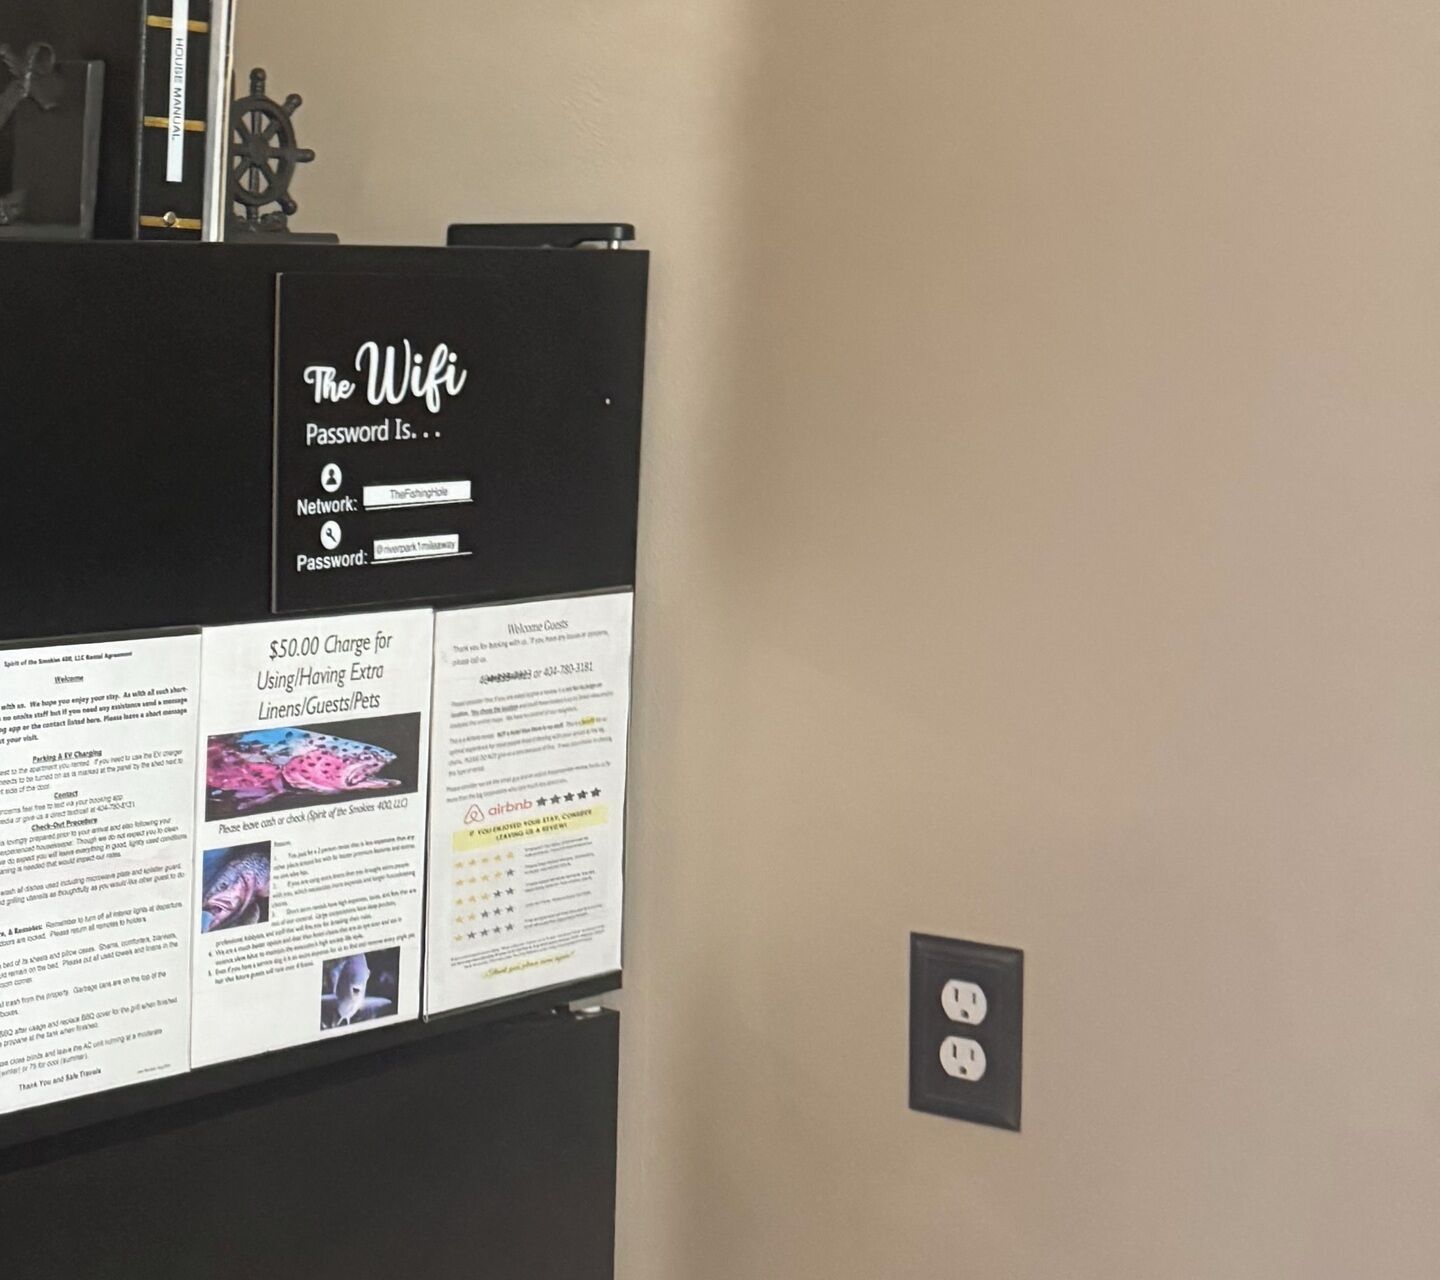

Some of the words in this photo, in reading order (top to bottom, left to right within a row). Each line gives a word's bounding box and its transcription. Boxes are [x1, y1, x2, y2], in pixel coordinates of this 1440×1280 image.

[173, 38, 184, 84] HOUSE
[171, 87, 182, 140] MANUAL
[304, 366, 355, 404] The
[355, 338, 467, 414] Wifi
[306, 418, 389, 446] Password
[297, 495, 358, 516] Network:
[297, 549, 368, 572] Password:
[507, 620, 543, 636] Welcome
[543, 618, 569, 631] Guests
[269, 636, 319, 661] $50.00
[324, 634, 371, 656] Charge
[374, 630, 393, 654] for
[54, 674, 83, 685] Welcome
[257, 666, 346, 693] Using/Having
[350, 662, 384, 681] Extra
[258, 691, 381, 721] Linens/Guests/Pets
[6, 736, 21, 744] your
[22, 733, 38, 742] visit.
[32, 753, 56, 764] Parking
[64, 751, 72, 761] EV
[73, 748, 102, 760] Charging
[53, 789, 78, 800] Contact
[488, 799, 533, 817] airbnb
[31, 820, 64, 833] Check-Out
[65, 816, 97, 828] Procedure
